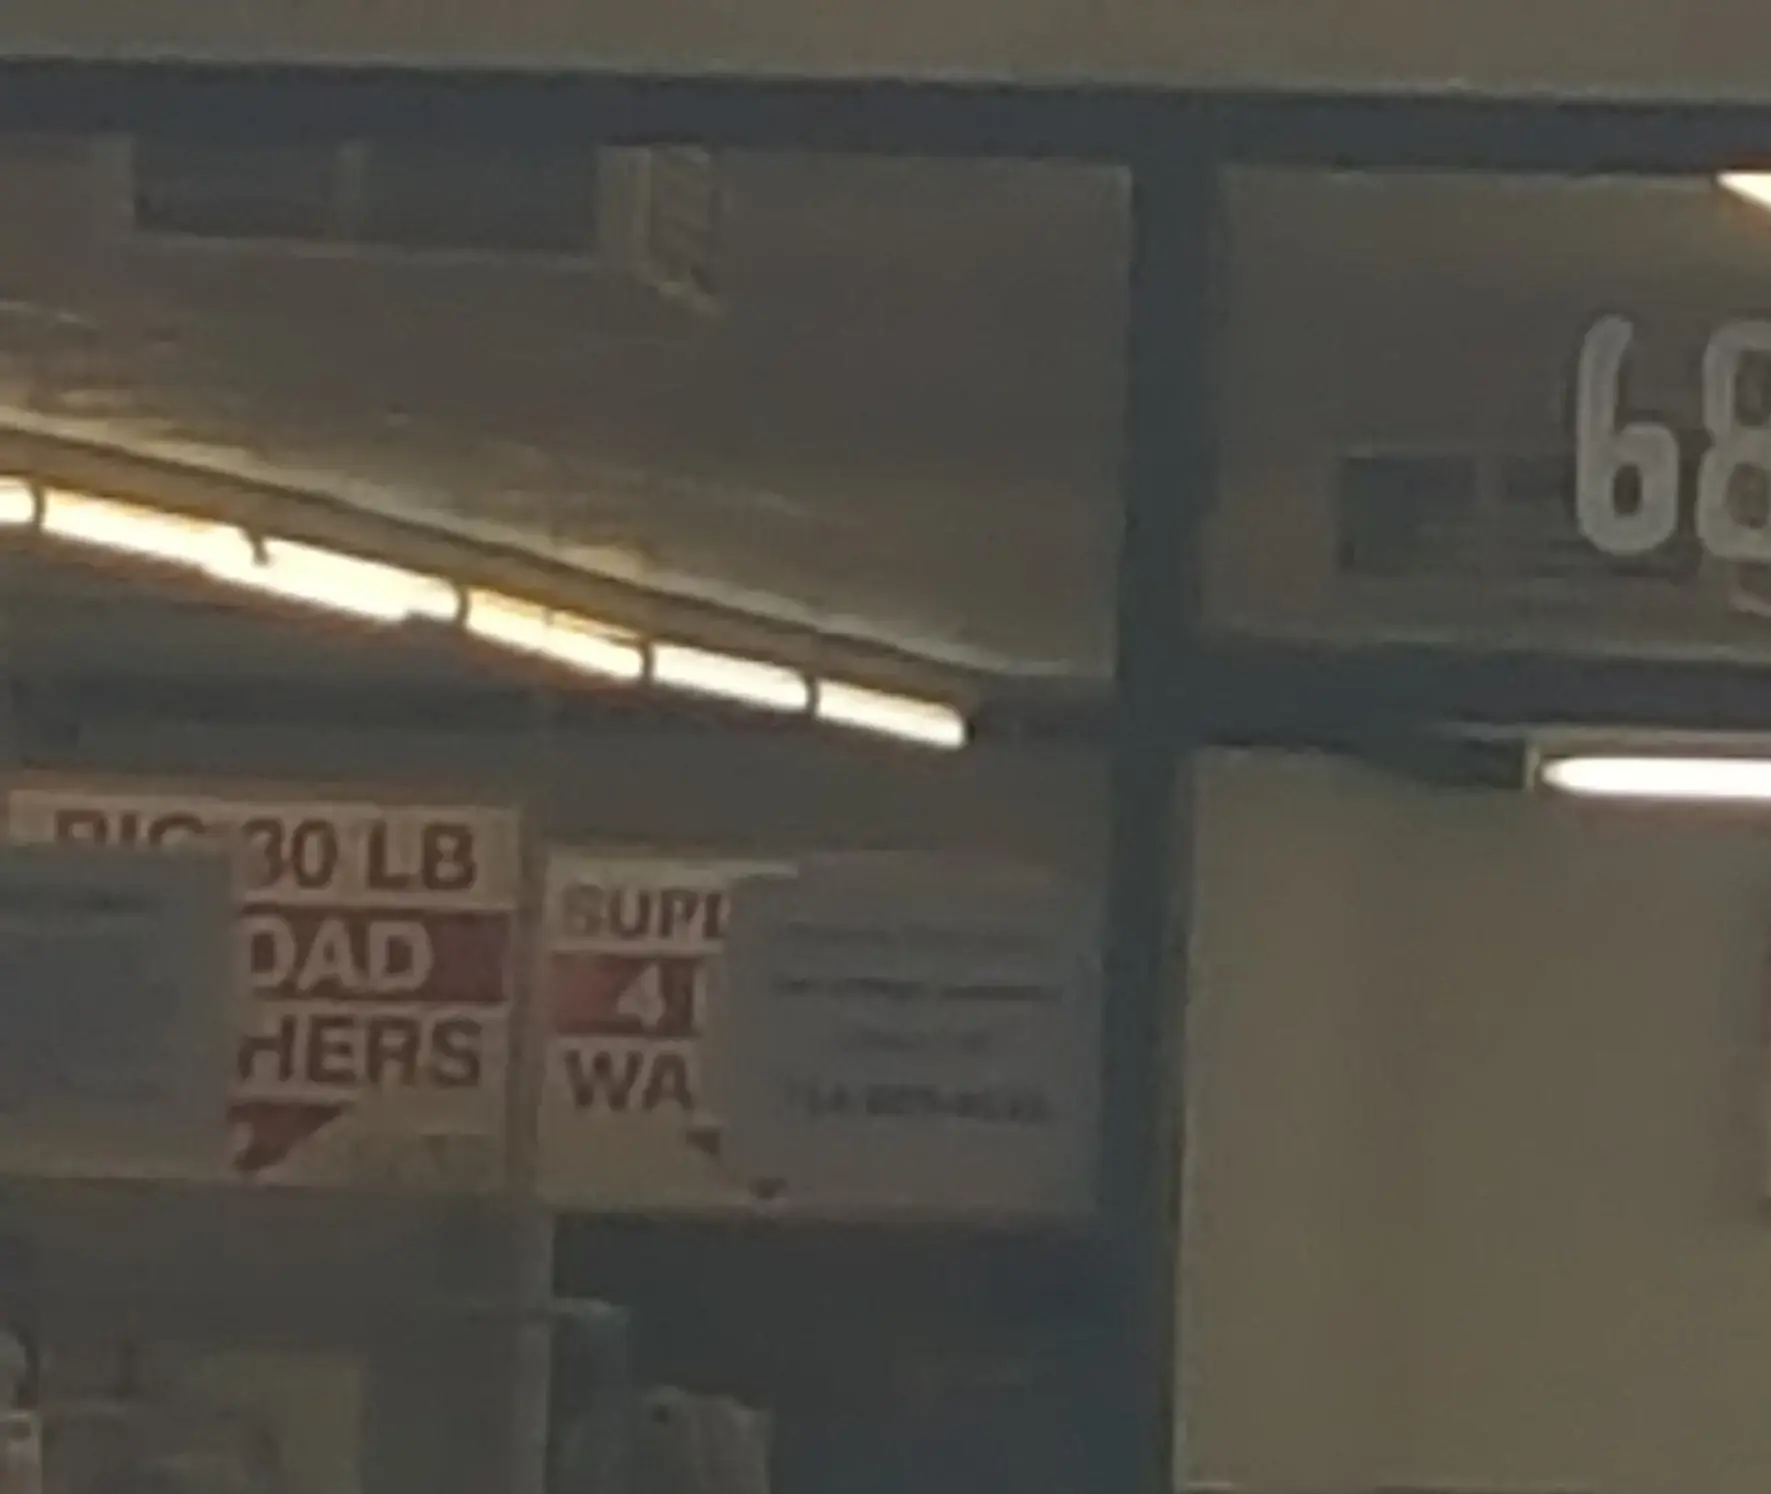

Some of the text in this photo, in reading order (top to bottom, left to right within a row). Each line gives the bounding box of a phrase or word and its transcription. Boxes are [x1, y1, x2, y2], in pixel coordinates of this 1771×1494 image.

[367, 820, 477, 891] LB
[240, 915, 436, 994] OAD
[614, 963, 666, 1029] 4
[236, 1014, 483, 1090] HERS
